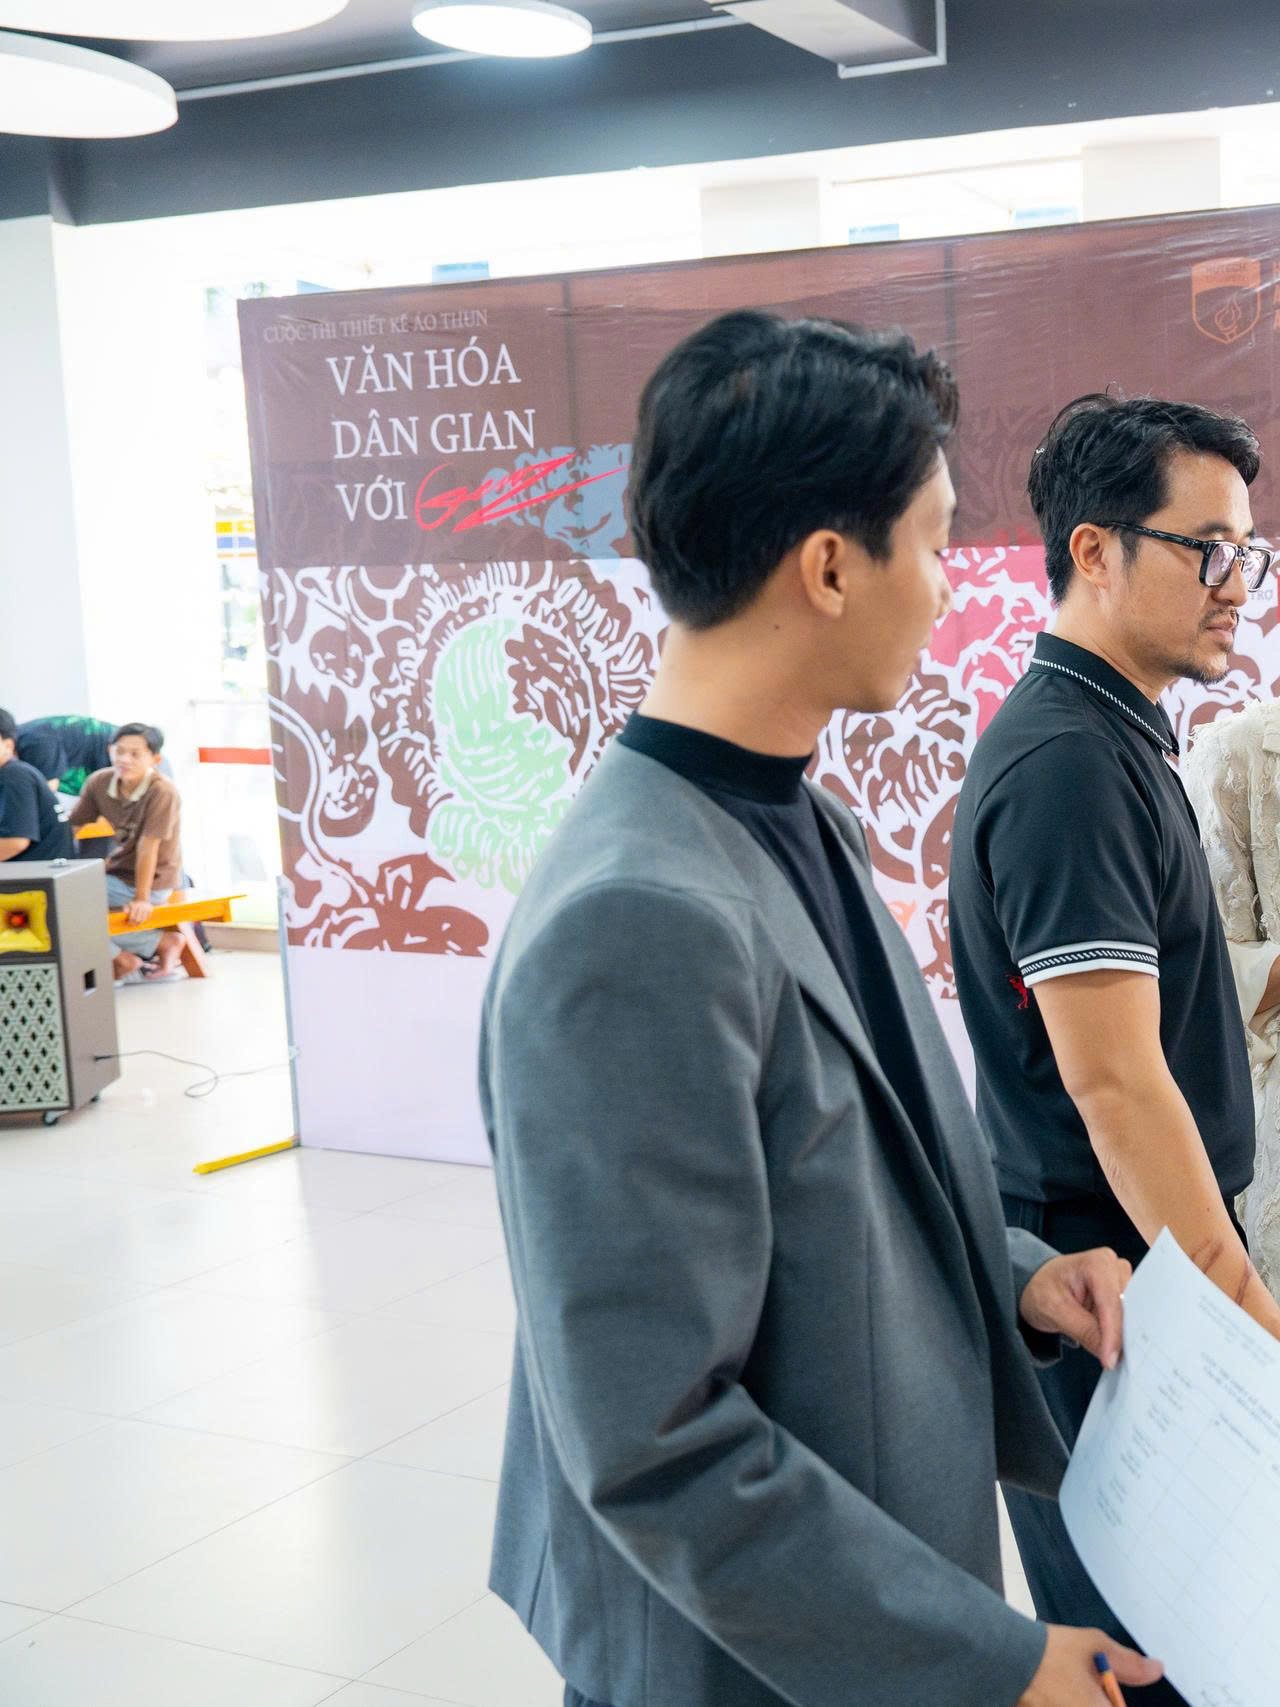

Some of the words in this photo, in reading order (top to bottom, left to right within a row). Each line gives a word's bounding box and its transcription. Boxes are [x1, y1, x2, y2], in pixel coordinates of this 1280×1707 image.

[309, 321, 336, 340] THI
[325, 345, 414, 395] VĂN
[424, 336, 522, 390] HÓA
[331, 408, 419, 460] DÂN
[430, 408, 536, 455] GIAN
[335, 475, 408, 522] VỚI
